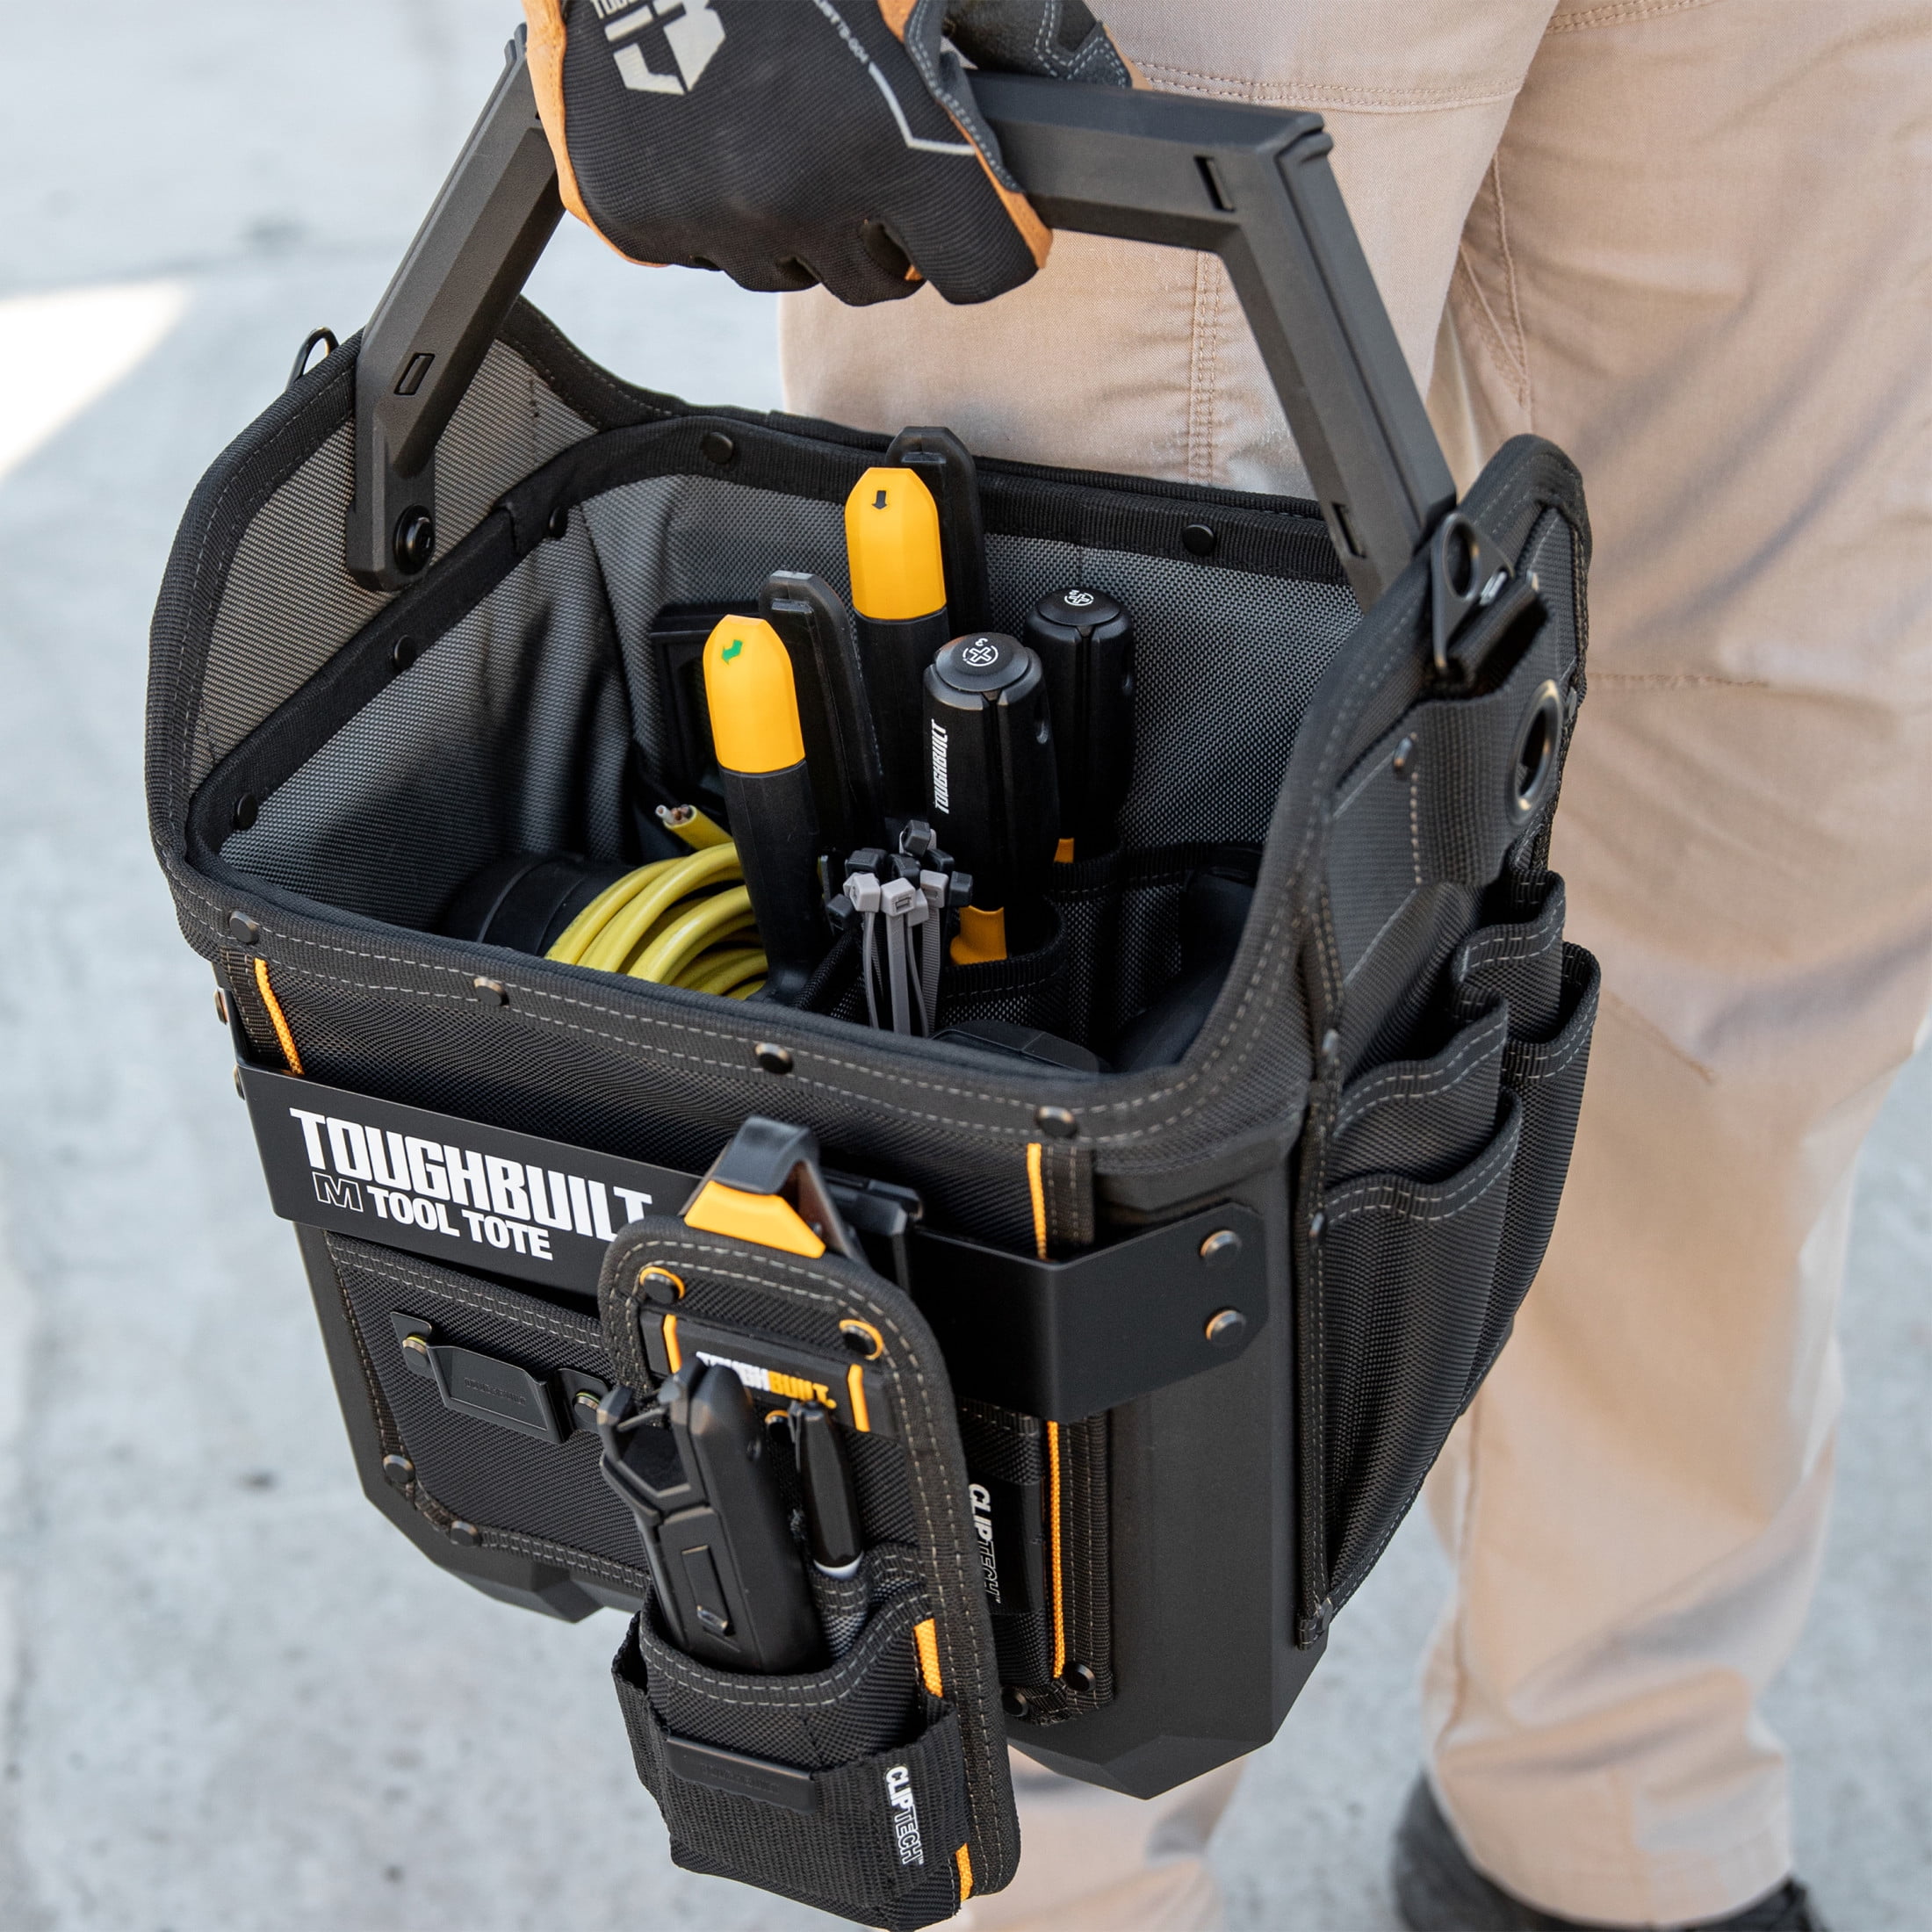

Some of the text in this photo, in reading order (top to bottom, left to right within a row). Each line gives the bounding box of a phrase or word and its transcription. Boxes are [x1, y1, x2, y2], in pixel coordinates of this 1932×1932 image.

[975, 638, 989, 646] 3
[931, 718, 949, 815] TOUGHBUILT
[289, 1107, 653, 1243] TOUGHBUILT
[313, 1171, 554, 1261] M TOOL TOTE
